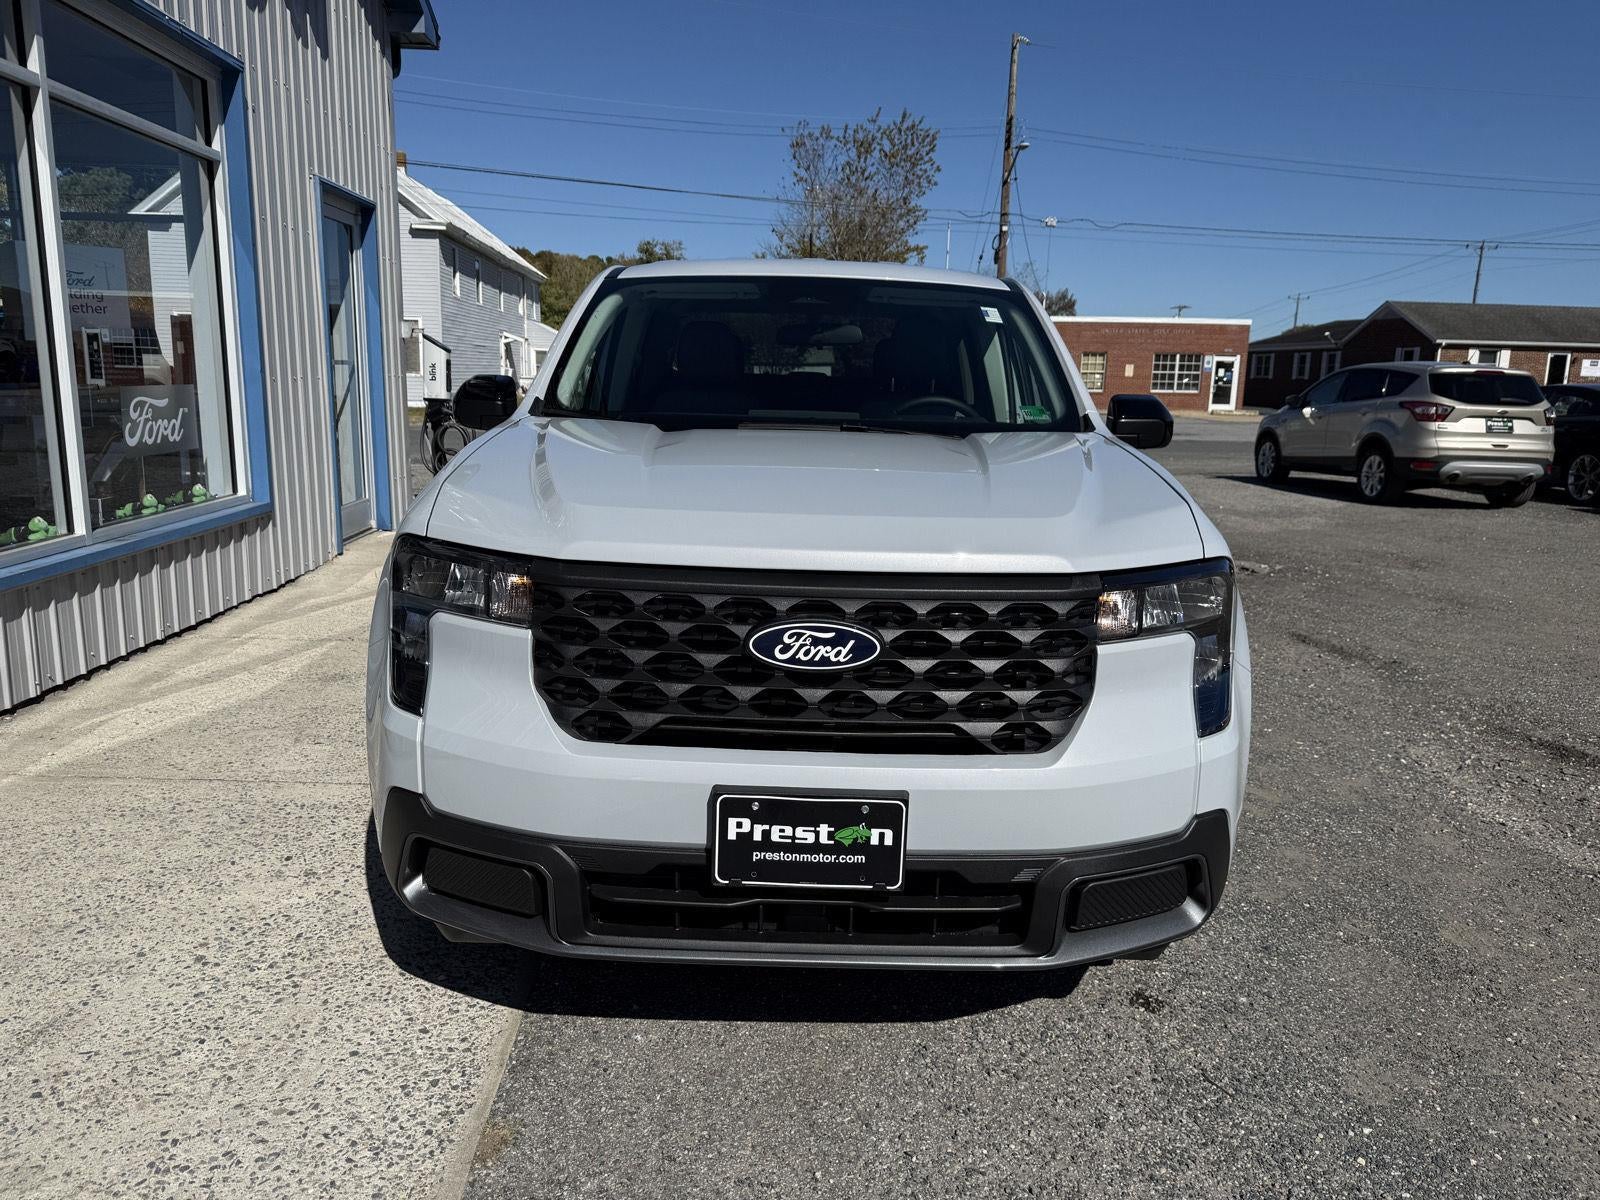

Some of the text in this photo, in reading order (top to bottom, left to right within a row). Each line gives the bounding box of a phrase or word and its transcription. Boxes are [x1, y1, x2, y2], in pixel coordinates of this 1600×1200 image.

[69, 288, 104, 303] lding
[70, 303, 108, 314] ether
[428, 362, 437, 381] blink
[125, 396, 184, 447] Ford
[774, 629, 855, 662] Ford
[727, 816, 893, 846] Prestn
[752, 850, 866, 864] prestonmotor.com
